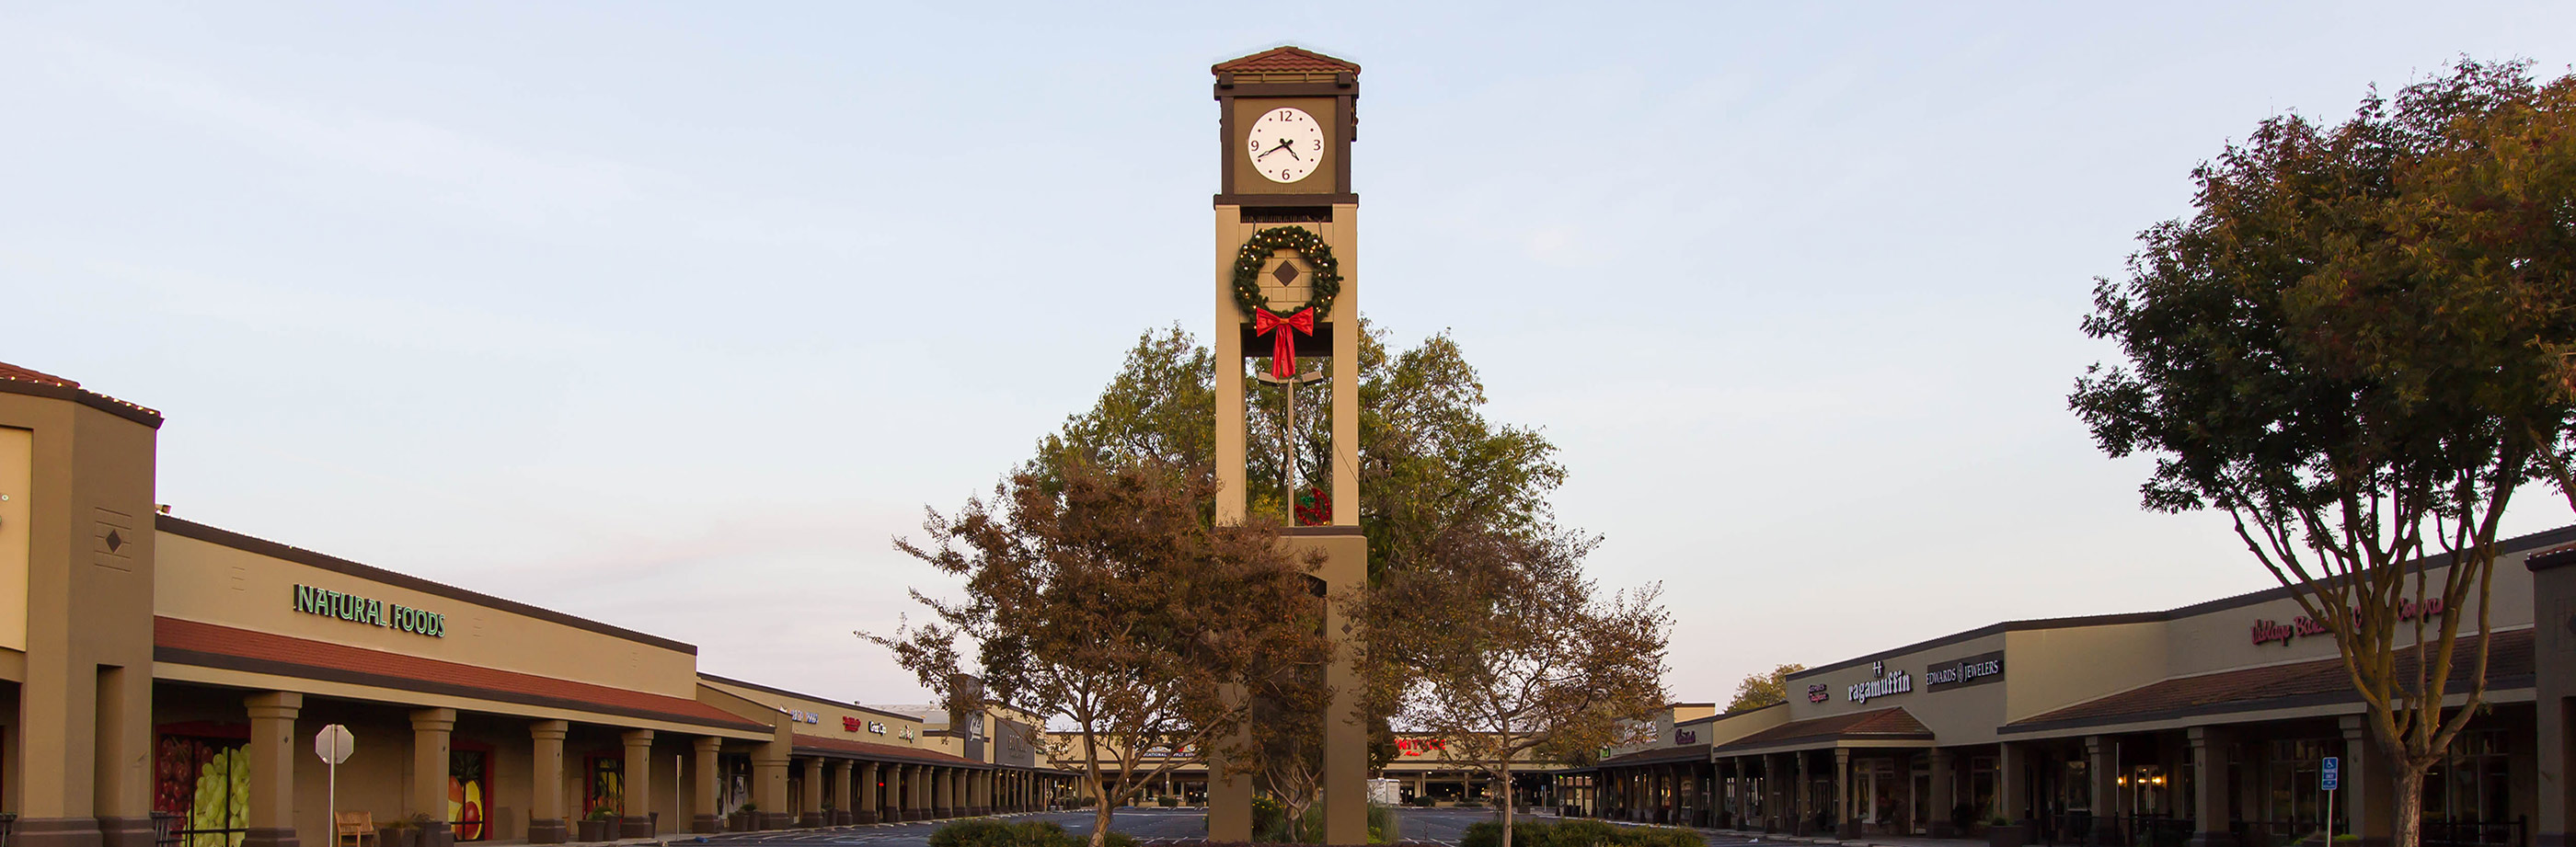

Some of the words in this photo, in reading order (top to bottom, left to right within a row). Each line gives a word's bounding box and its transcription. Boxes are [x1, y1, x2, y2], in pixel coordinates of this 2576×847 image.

[1280, 110, 1293, 122] 12
[1251, 140, 1259, 152] 9
[1313, 139, 1321, 151] 3
[1282, 168, 1291, 180] 6
[296, 583, 387, 627] NATURAL
[393, 603, 446, 638] FOODS
[2250, 617, 2292, 647] Village
[1926, 668, 1957, 685] EDWARDS
[1963, 659, 1999, 682] JEWELERS
[1847, 670, 1910, 704] ragamuffin
